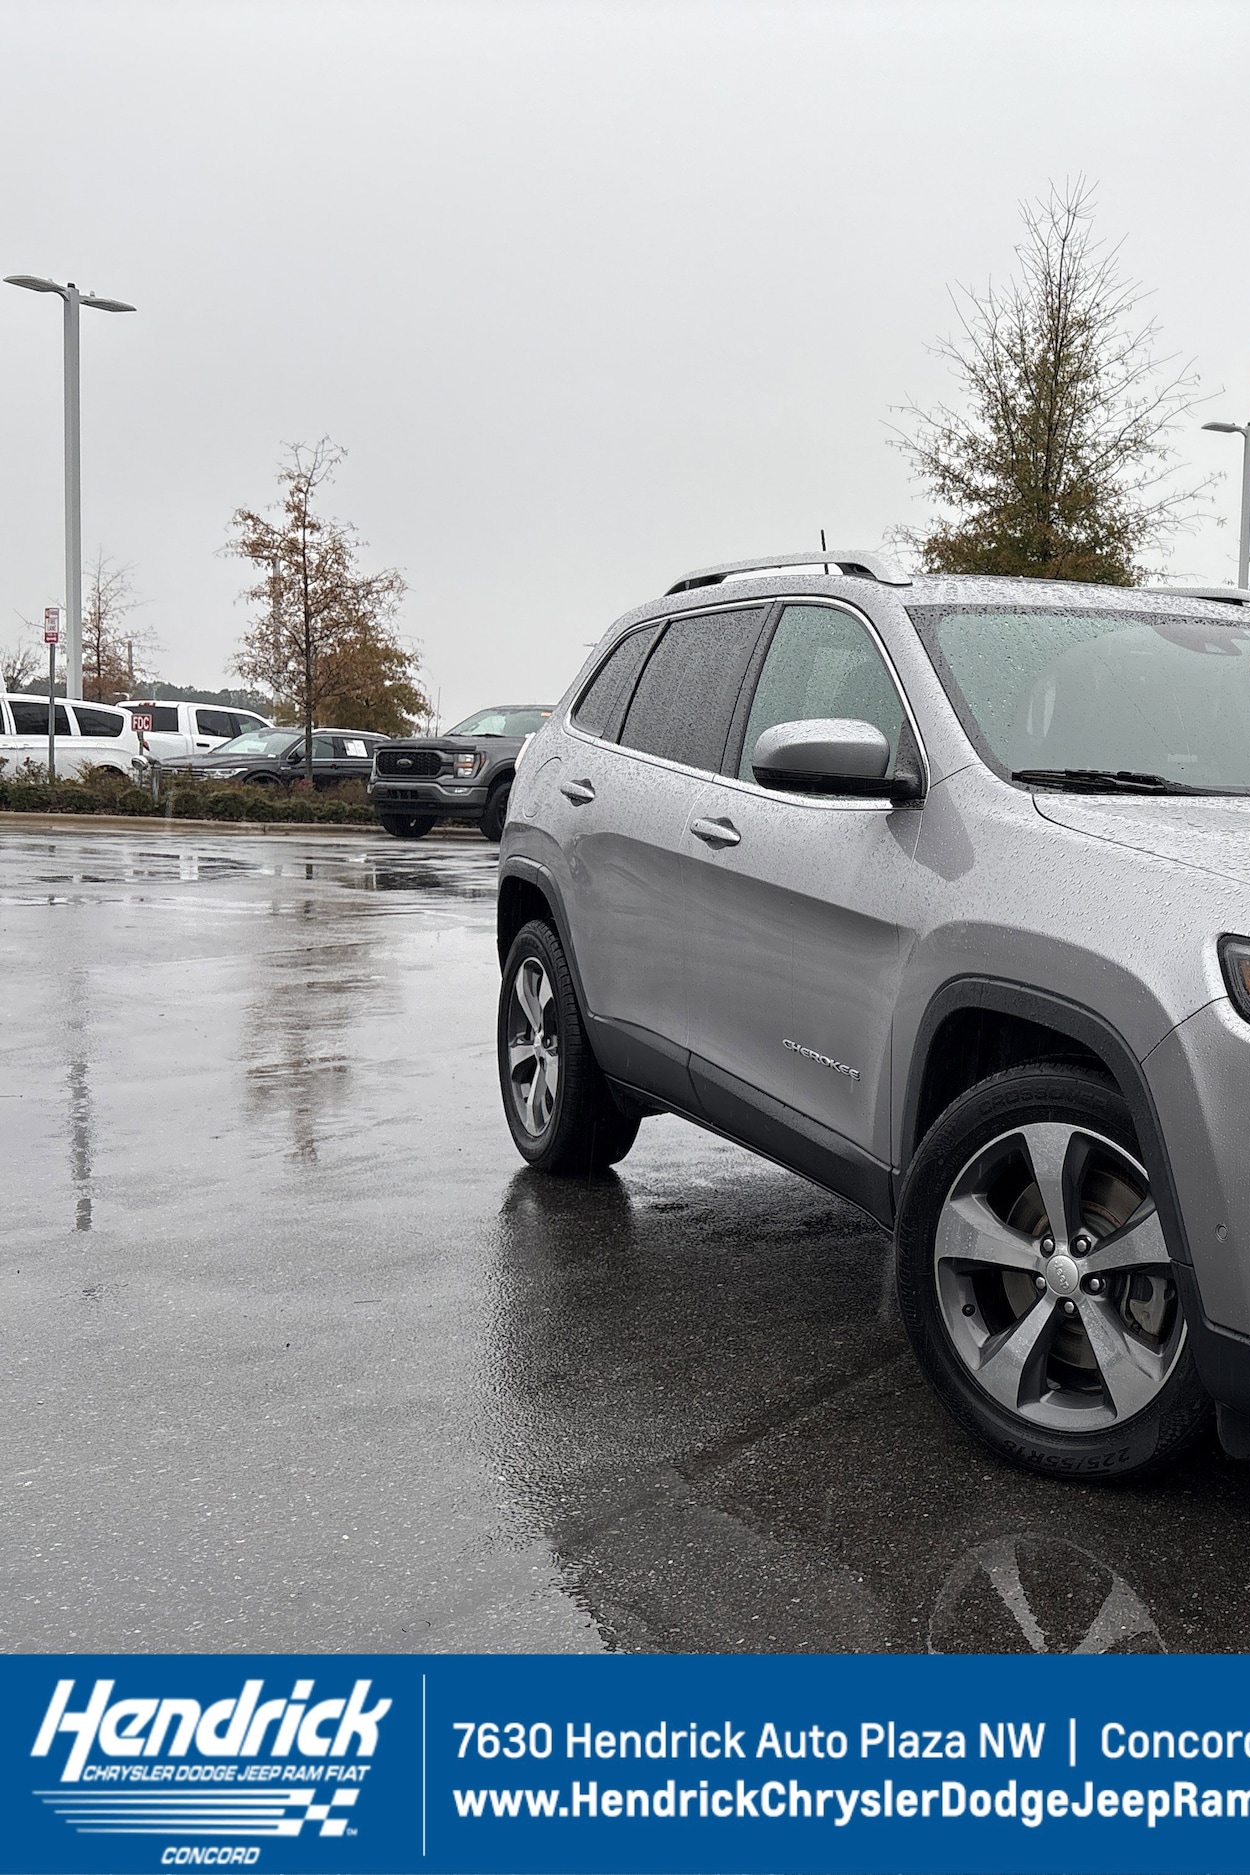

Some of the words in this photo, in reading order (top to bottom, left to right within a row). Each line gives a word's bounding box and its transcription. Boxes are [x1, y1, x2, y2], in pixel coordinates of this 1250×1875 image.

[133, 716, 150, 730] FDC
[781, 1038, 861, 1081] CHEROKEE
[1053, 1259, 1070, 1290] Jeep
[1002, 1439, 1132, 1471] 225/55R18
